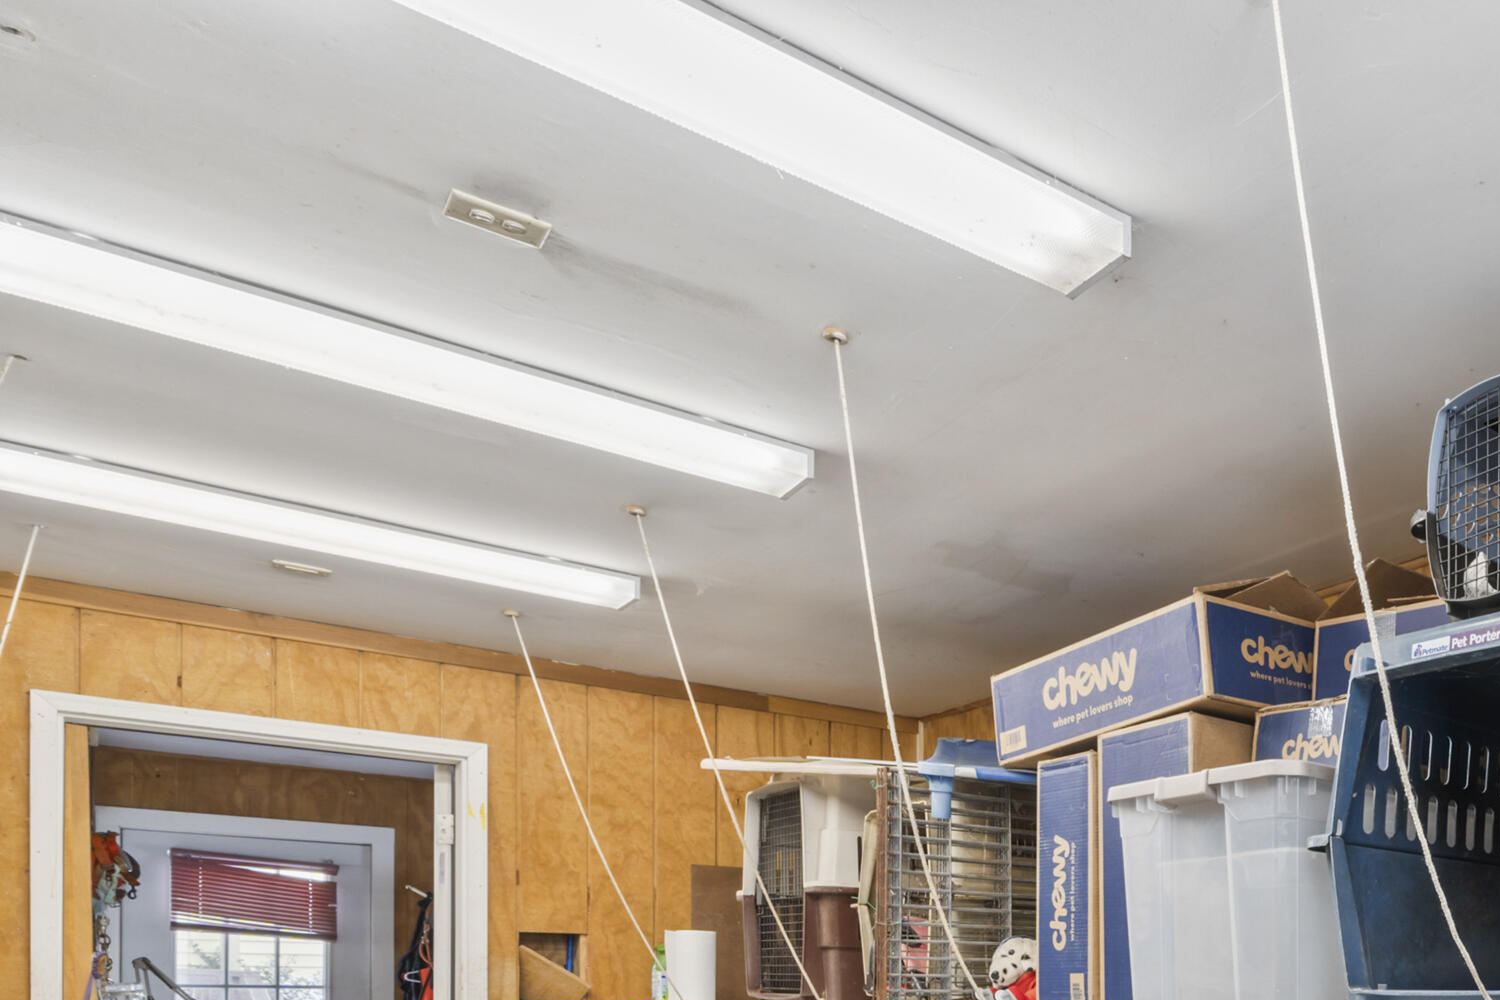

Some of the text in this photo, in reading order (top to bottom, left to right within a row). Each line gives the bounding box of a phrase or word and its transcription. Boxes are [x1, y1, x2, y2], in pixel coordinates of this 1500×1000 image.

[1451, 636, 1467, 650] Pet
[1469, 628, 1500, 646] Porter
[1042, 647, 1137, 711] chewy
[1053, 694, 1134, 728] where pet lovers shop
[1049, 834, 1070, 952] chewy
